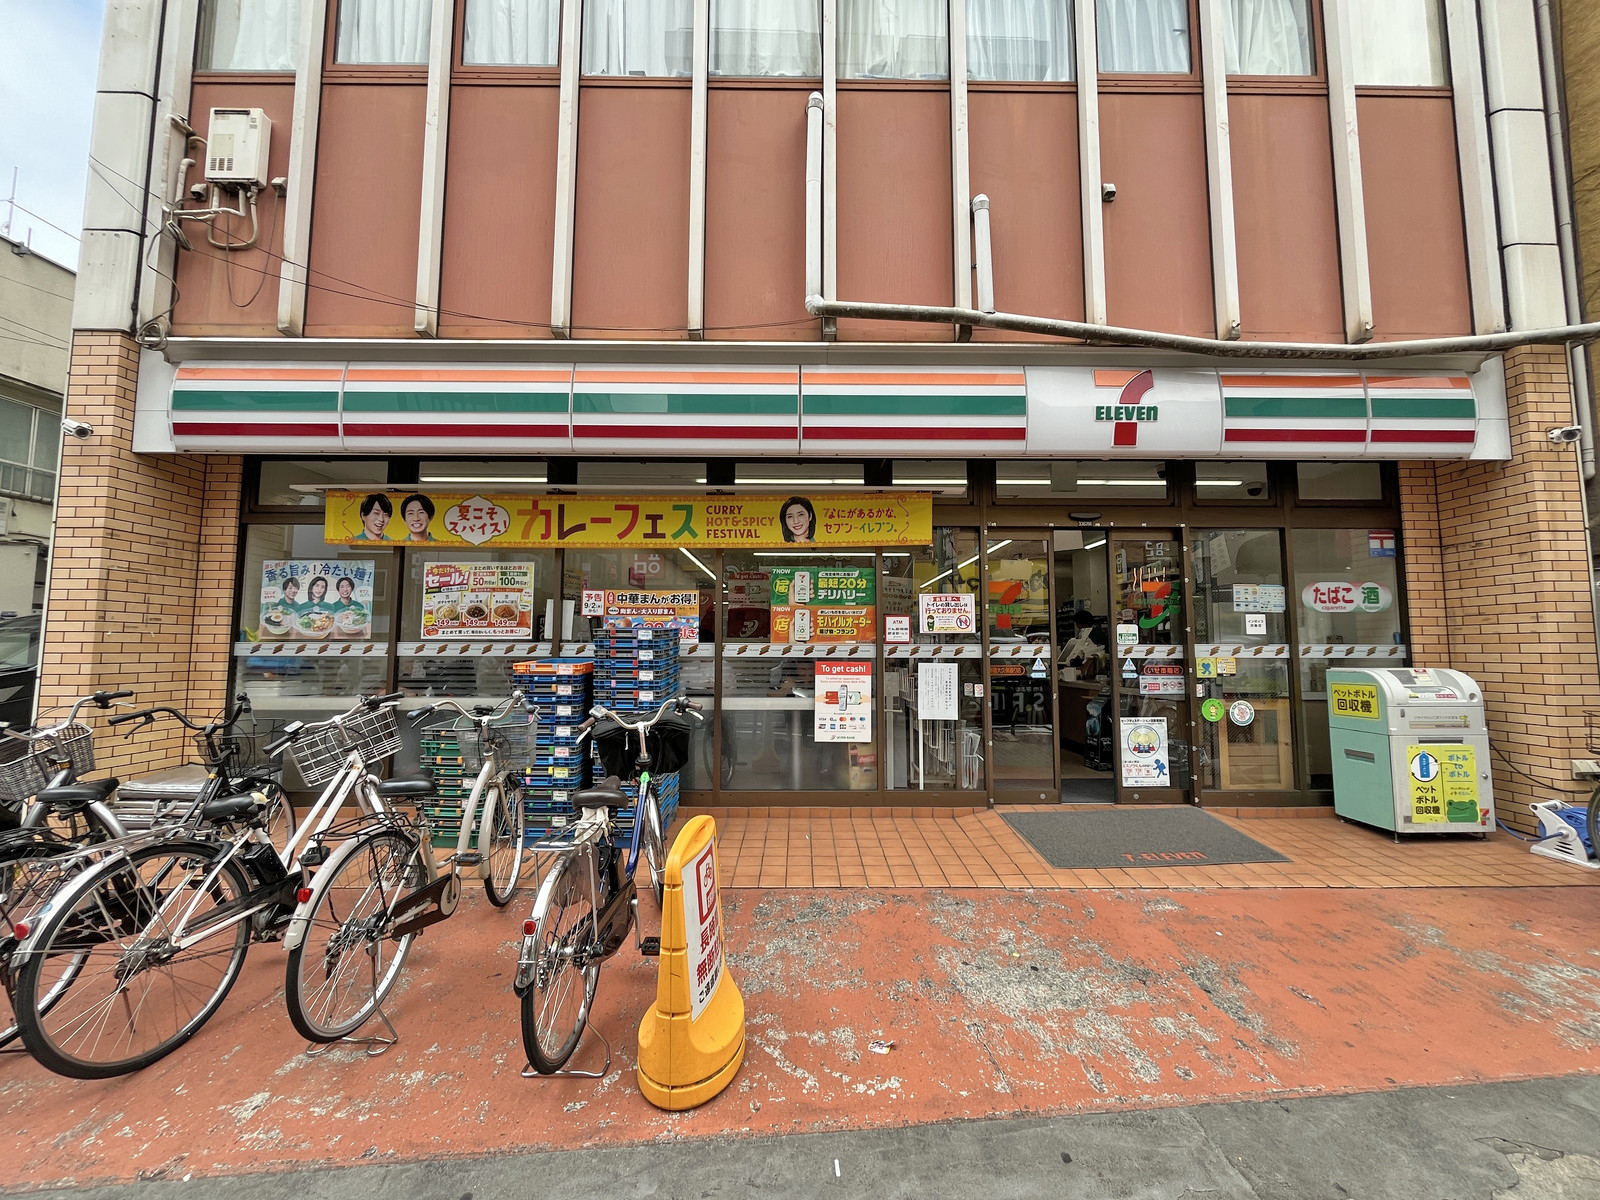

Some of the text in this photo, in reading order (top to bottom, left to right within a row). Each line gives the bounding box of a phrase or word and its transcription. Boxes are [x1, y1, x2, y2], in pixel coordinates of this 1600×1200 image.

[458, 505, 499, 521] 夏こそ
[706, 505, 743, 515] CURRY
[517, 499, 699, 541] カレーフェス
[706, 516, 775, 529] HOT&SPICY
[449, 520, 508, 535] スパイス!
[706, 528, 761, 540] FESTIVAL
[426, 571, 470, 588] セール!
[818, 578, 867, 589] 最短20分
[585, 594, 602, 602] 予告
[617, 593, 697, 605] 中華まんがお得!
[818, 589, 866, 600] デリバリー
[1313, 586, 1380, 605] たばこ 酒
[817, 616, 872, 627] モバイルオーダー
[821, 664, 830, 672] To
[831, 665, 844, 674] get
[1333, 689, 1376, 699] ペットボトル
[1337, 698, 1372, 713] 回収機
[1447, 754, 1469, 763] ボトル
[1449, 771, 1471, 780] ボトル
[1416, 785, 1436, 794] ペット
[1416, 796, 1438, 804] ボトル
[1416, 806, 1441, 815] 回収機
